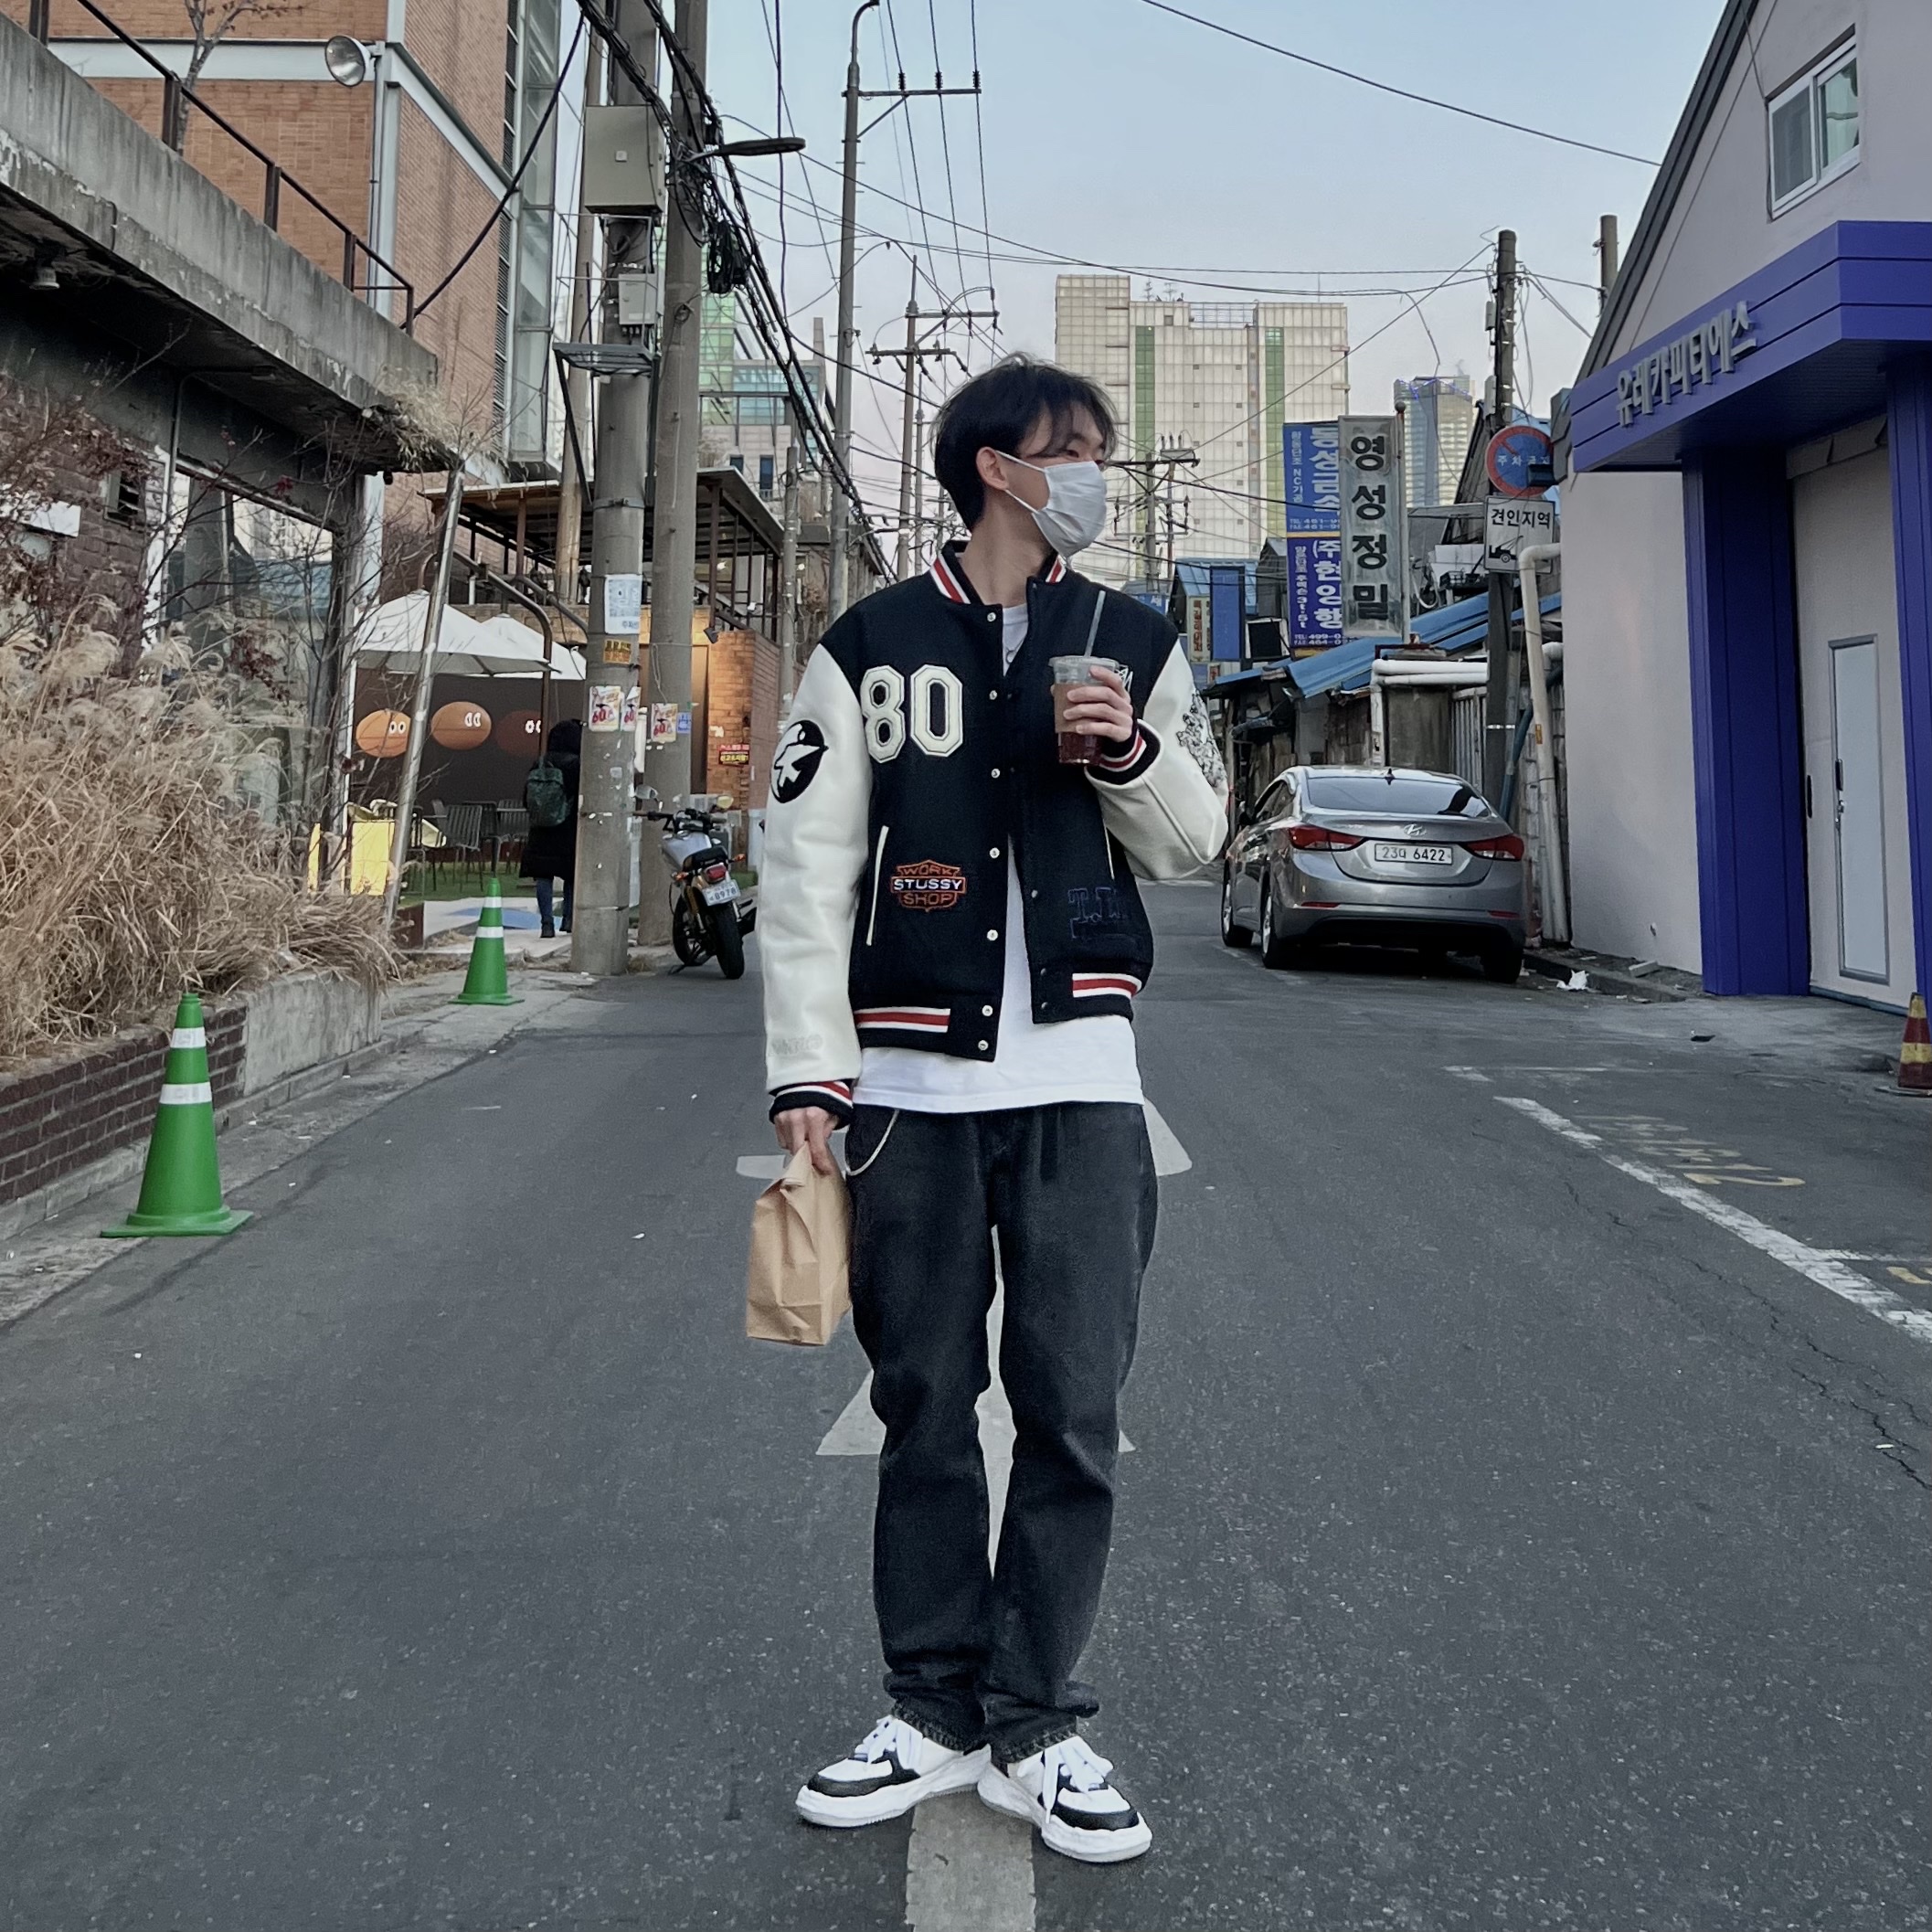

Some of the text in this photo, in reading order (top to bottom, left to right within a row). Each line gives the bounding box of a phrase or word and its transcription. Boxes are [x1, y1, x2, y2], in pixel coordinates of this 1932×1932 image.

[1617, 300, 1757, 428] 유레카피티에스
[1351, 435, 1388, 621] 영성정밀
[1491, 507, 1551, 530] 견인지역
[860, 663, 963, 764] 80
[1413, 847, 1445, 862] 6422
[903, 864, 952, 876] WORK
[894, 878, 962, 890] STUSSY
[903, 893, 951, 905] SHOP
